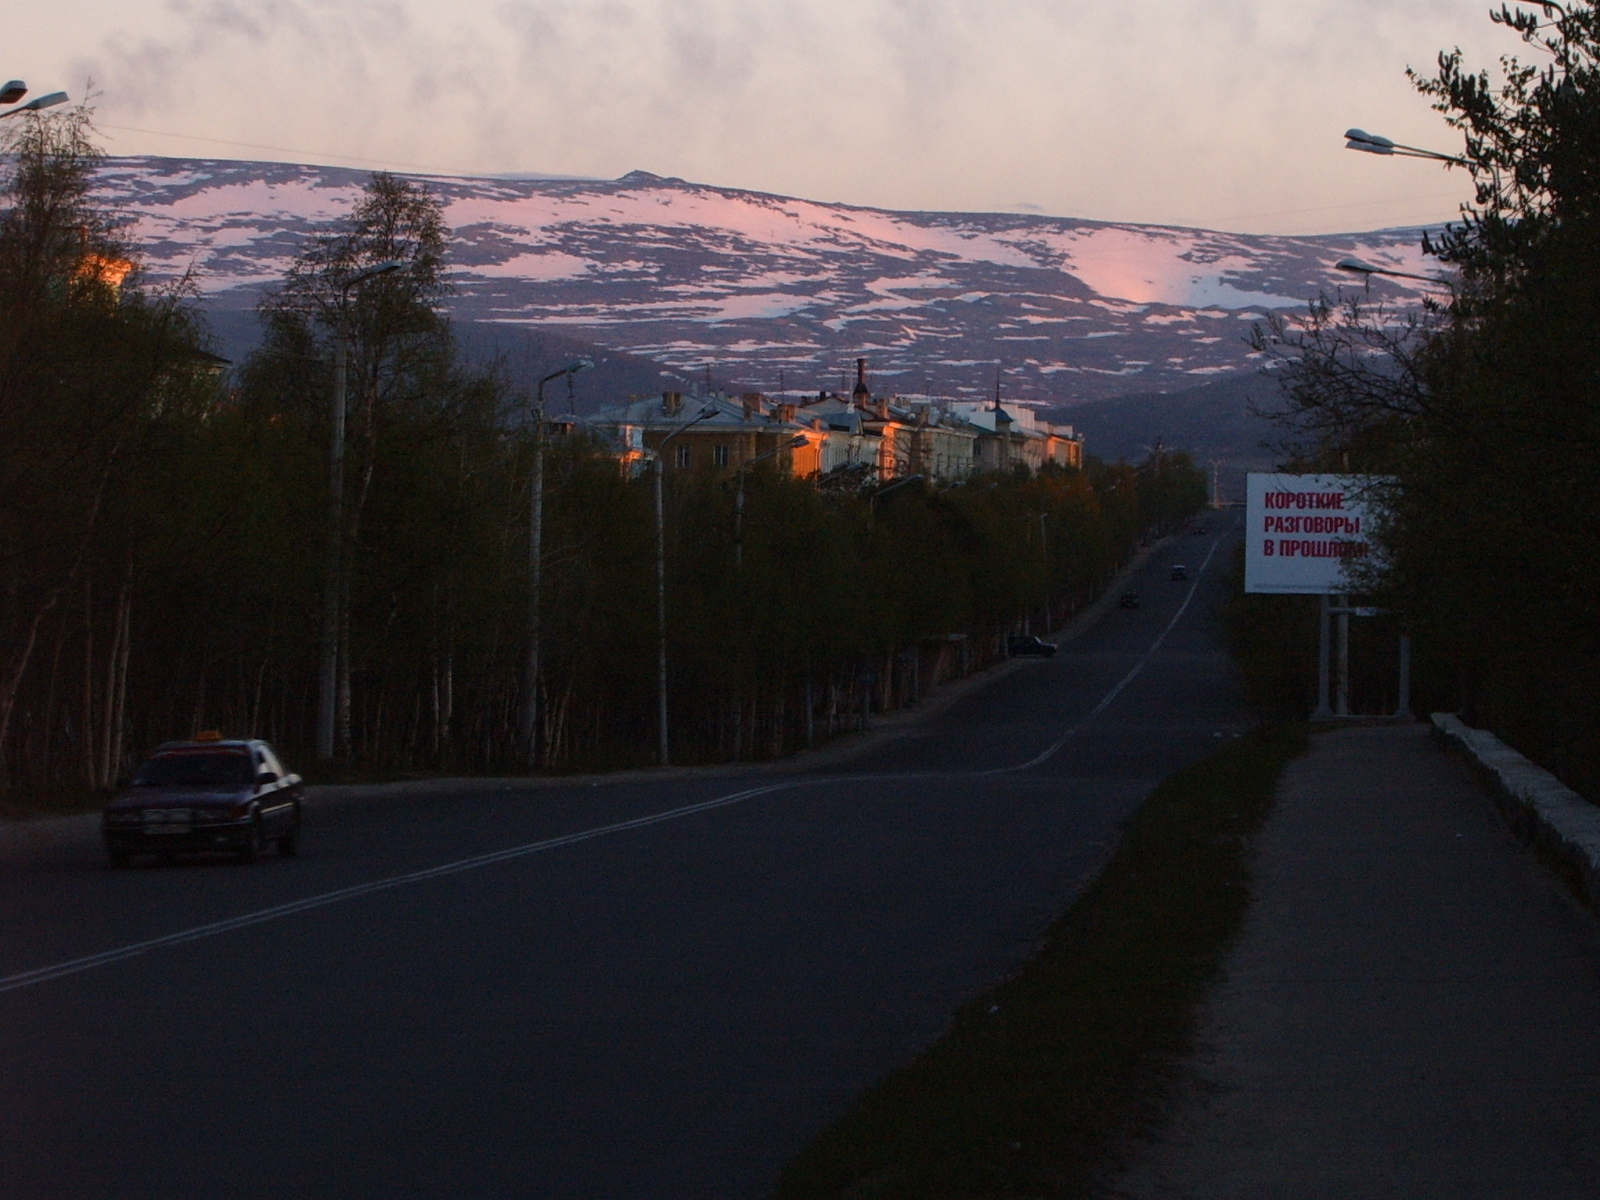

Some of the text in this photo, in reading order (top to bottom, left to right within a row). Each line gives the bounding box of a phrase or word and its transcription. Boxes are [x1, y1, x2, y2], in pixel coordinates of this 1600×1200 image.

[1265, 492, 1345, 509] КОРОТКИЕ
[1264, 516, 1360, 533] РАЗГОВОРЫ
[1264, 539, 1274, 556] В
